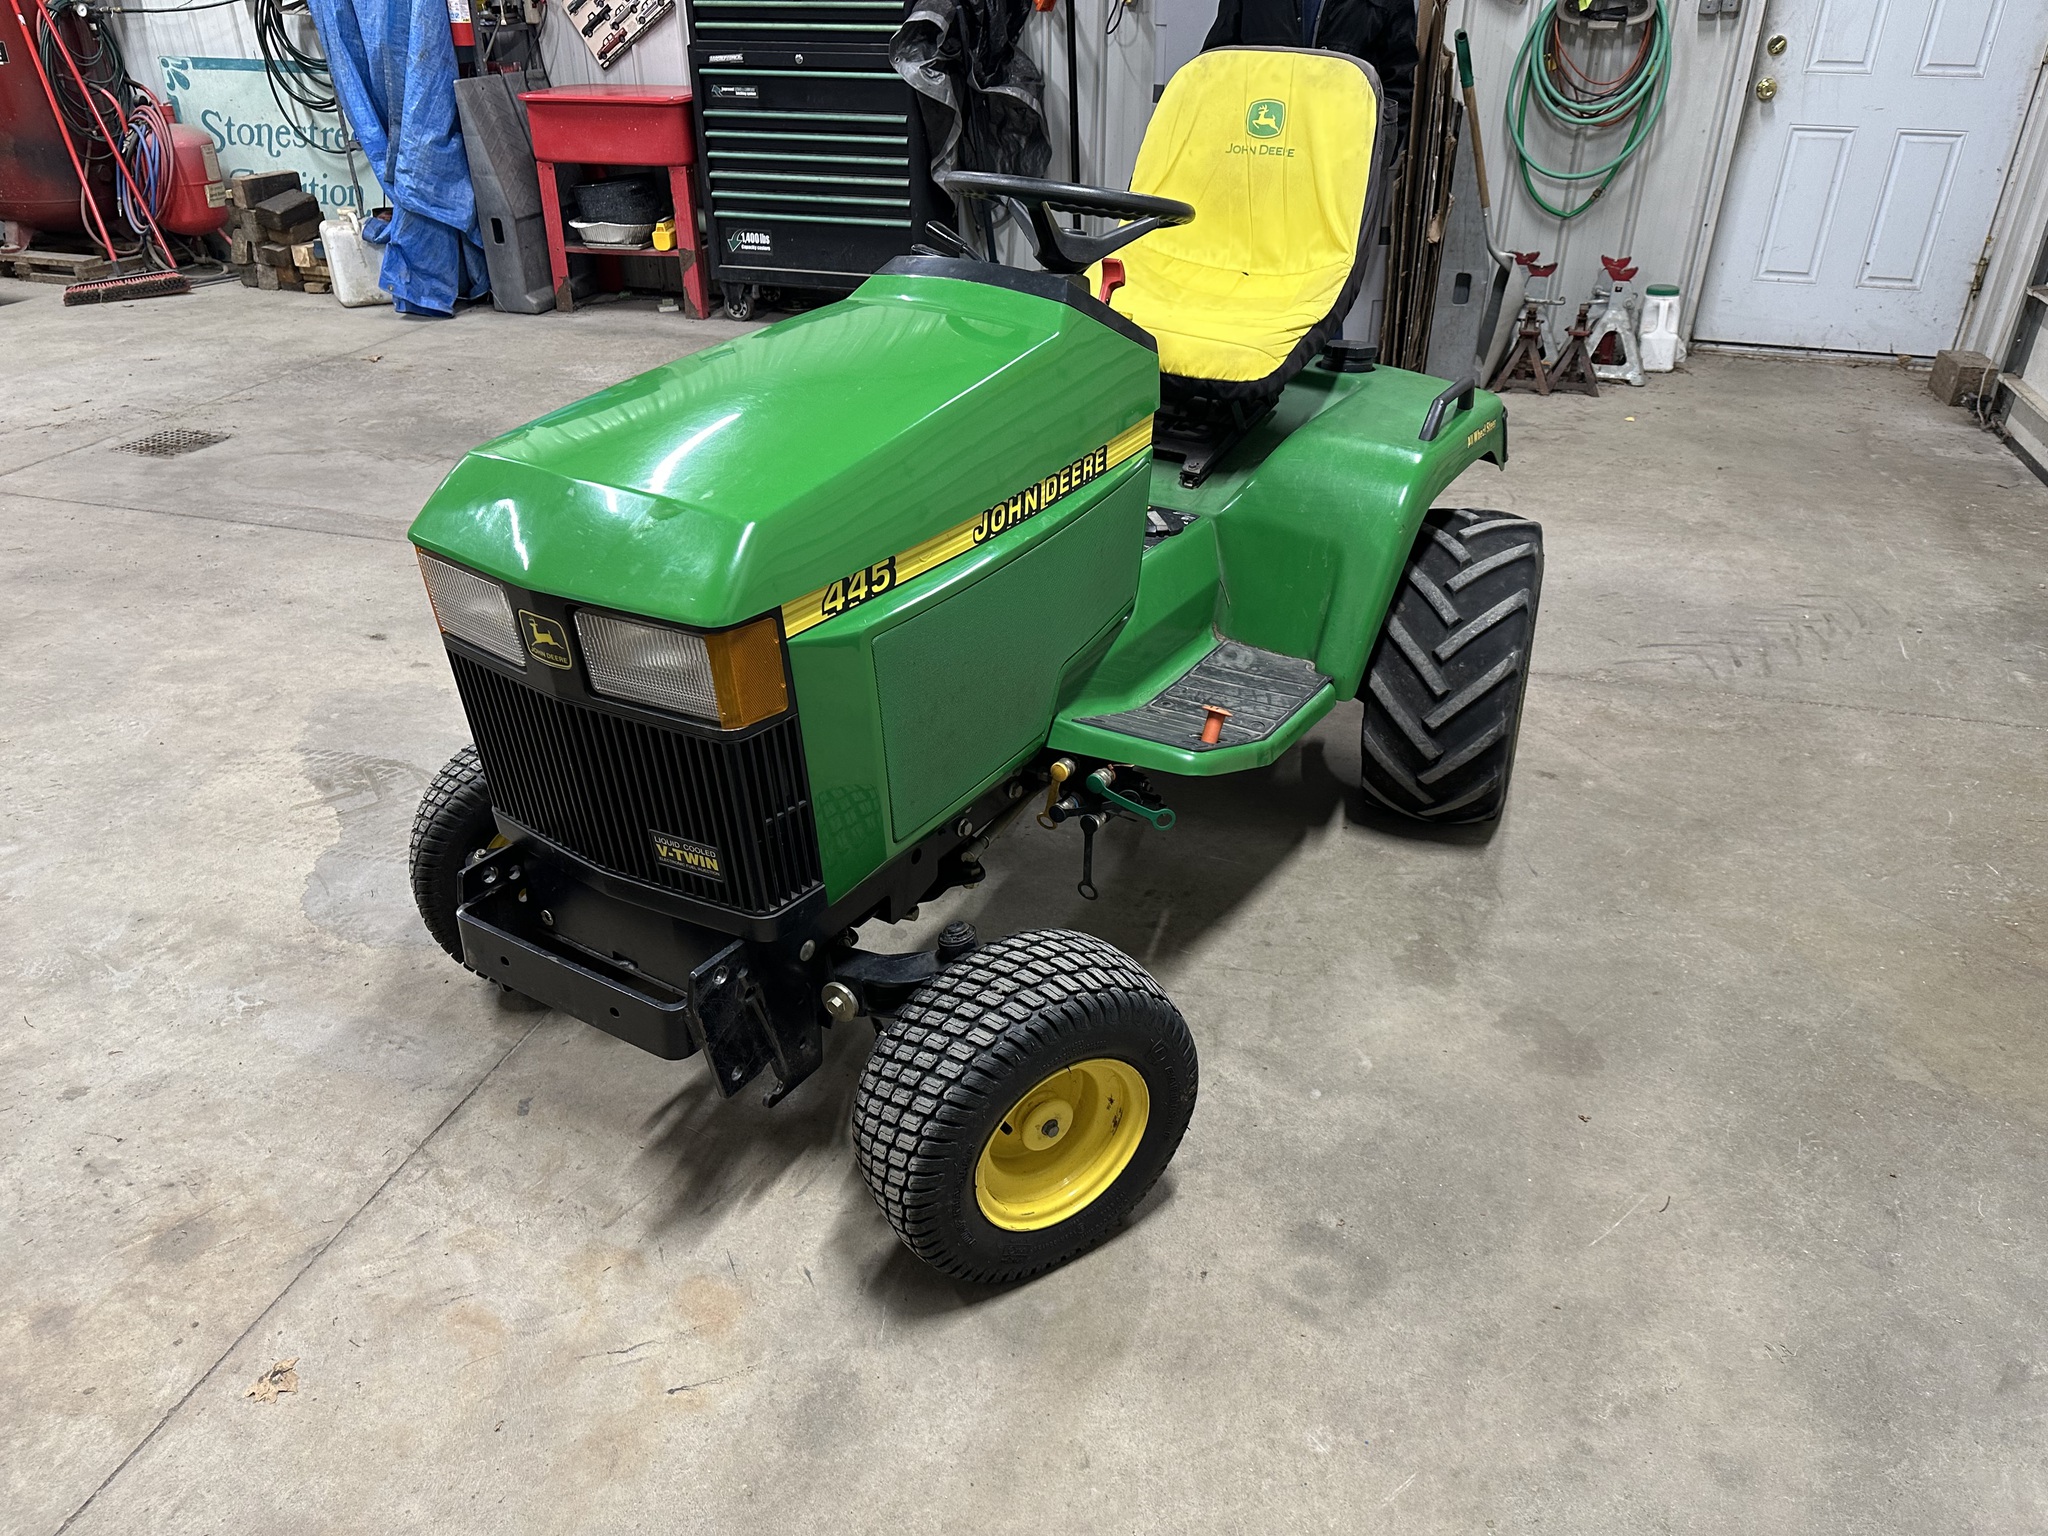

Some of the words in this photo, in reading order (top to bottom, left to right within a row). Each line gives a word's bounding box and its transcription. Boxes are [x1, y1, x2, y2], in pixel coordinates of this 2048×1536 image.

[201, 109, 358, 158] Stonestre
[973, 484, 1038, 542] JOHN
[1045, 447, 1105, 503] DEERE
[823, 558, 891, 612] 445
[546, 652, 569, 665] DEERE
[653, 835, 680, 848] LIQUID
[682, 843, 716, 858] COOLED
[655, 843, 720, 872] V-TWIN
